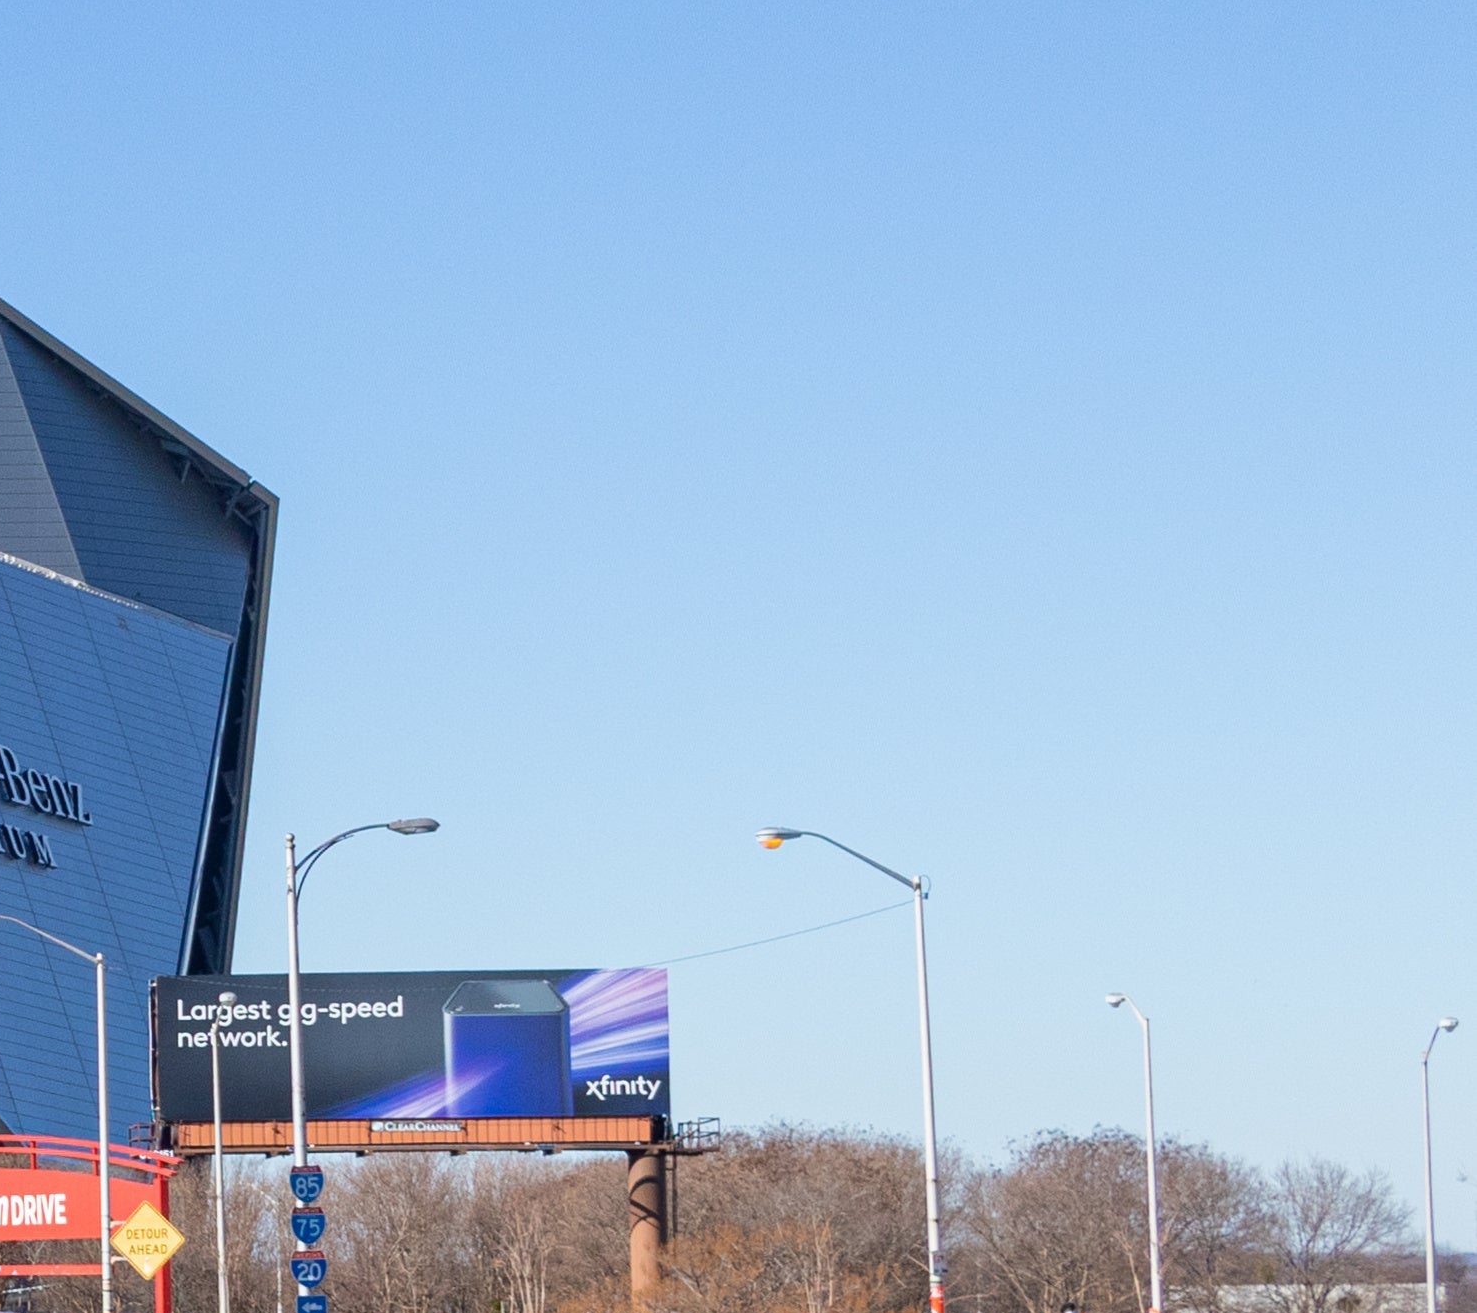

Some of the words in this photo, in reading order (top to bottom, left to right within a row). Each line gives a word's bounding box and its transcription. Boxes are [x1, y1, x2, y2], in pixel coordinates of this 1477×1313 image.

[177, 999, 272, 1027] Largest
[277, 995, 404, 1025] gg-speed
[586, 1074, 661, 1101] xfinity
[295, 1177, 319, 1198] 85
[10, 1193, 68, 1226] DRIVE
[126, 1228, 169, 1240] DETOUR
[296, 1219, 320, 1237] 75
[129, 1244, 168, 1255] AHEAD
[297, 1263, 322, 1282] 20
